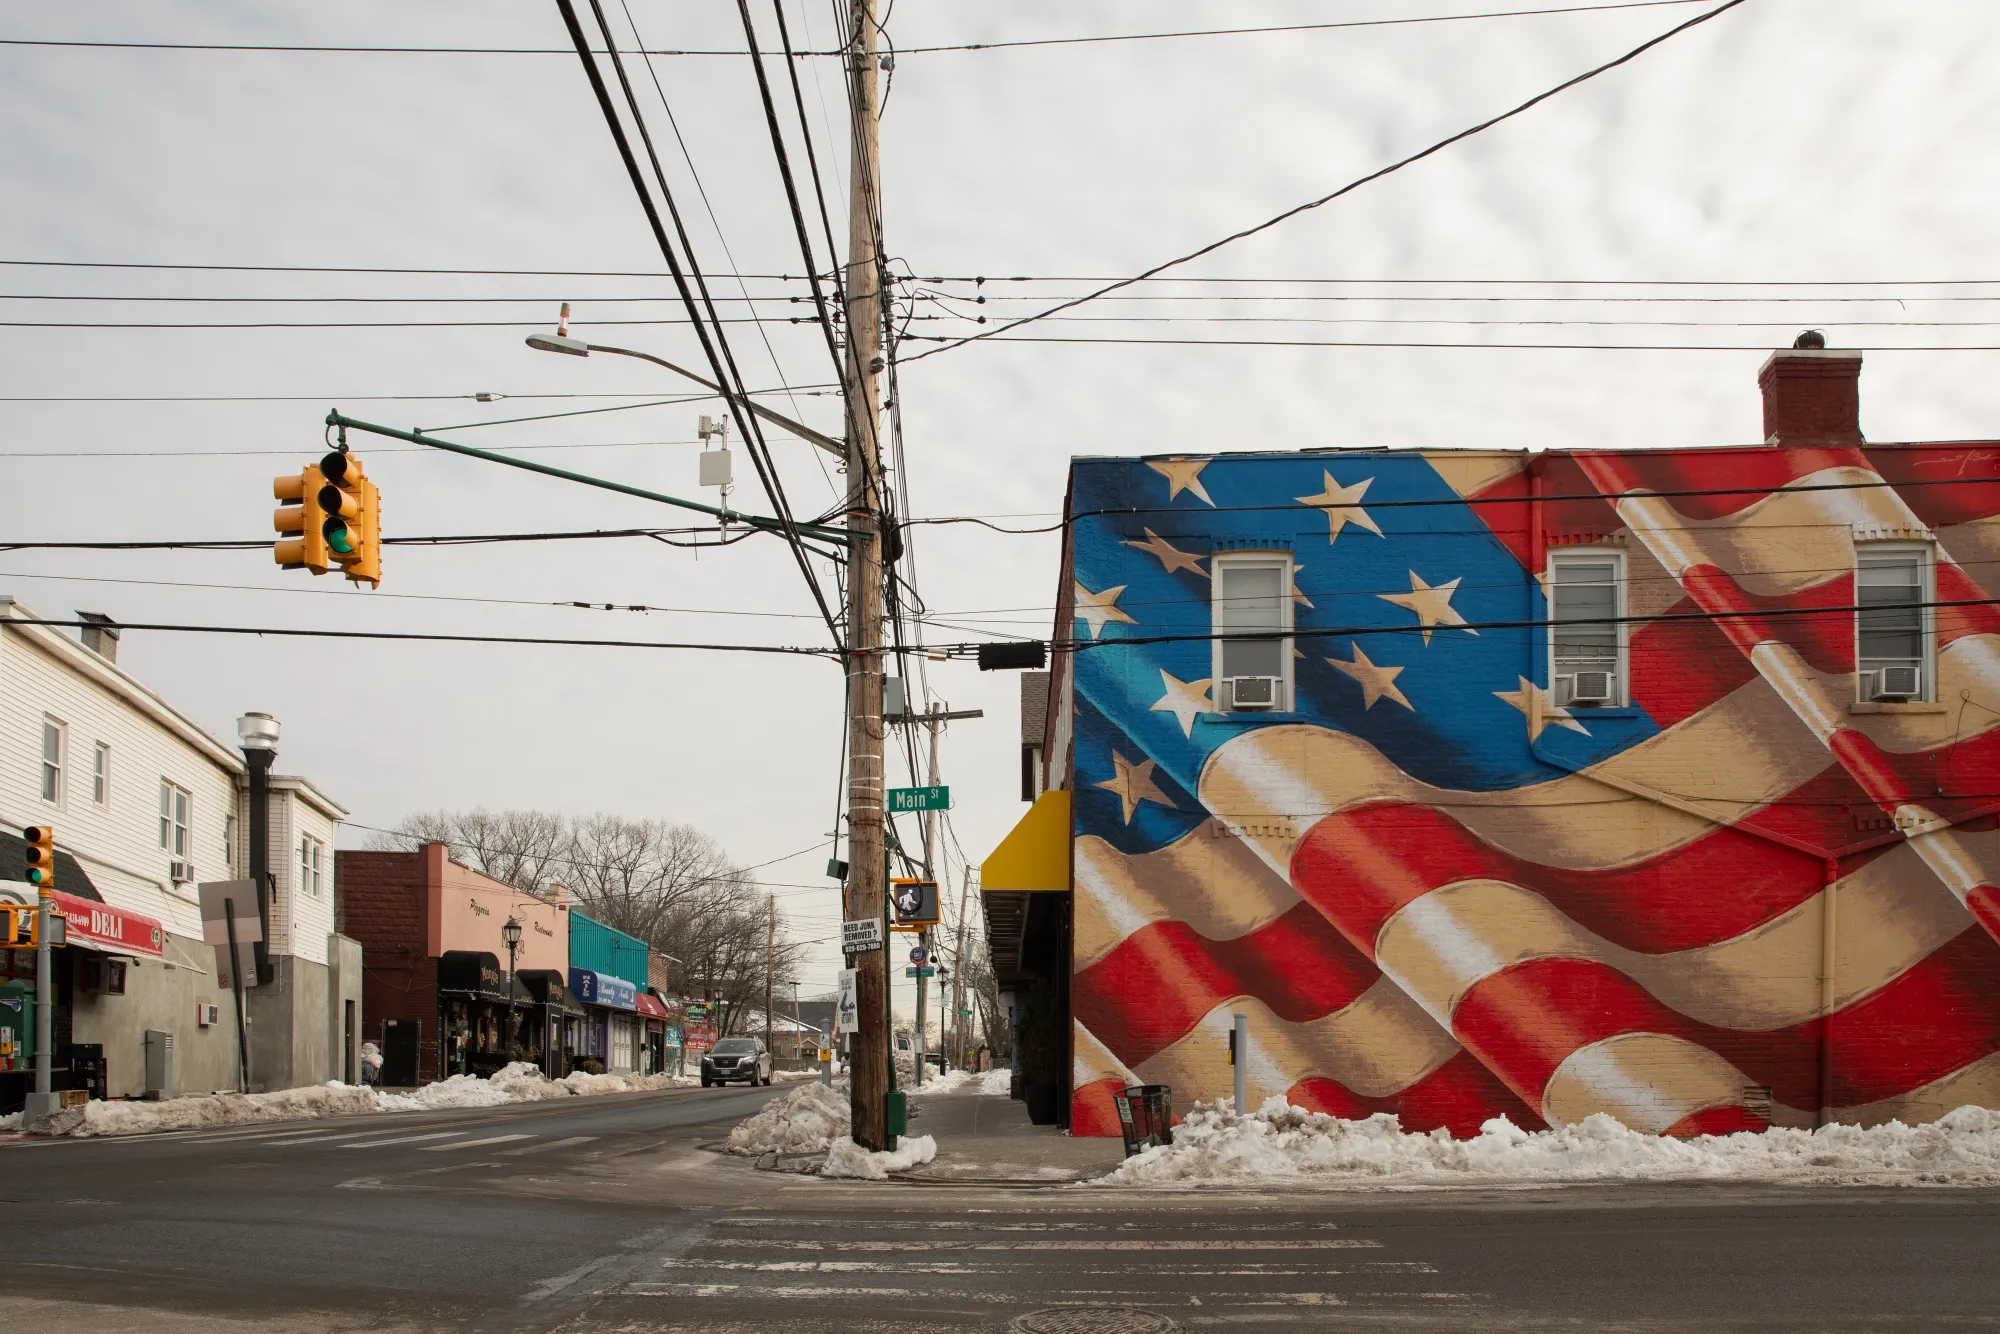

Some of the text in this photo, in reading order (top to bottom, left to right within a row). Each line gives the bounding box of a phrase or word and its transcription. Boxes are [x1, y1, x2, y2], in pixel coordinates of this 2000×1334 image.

[896, 788, 940, 809] Main St
[91, 910, 122, 939] DELI
[844, 921, 875, 932] NEED JUNK
[844, 930, 872, 942] REMOVED
[872, 929, 878, 938] ?
